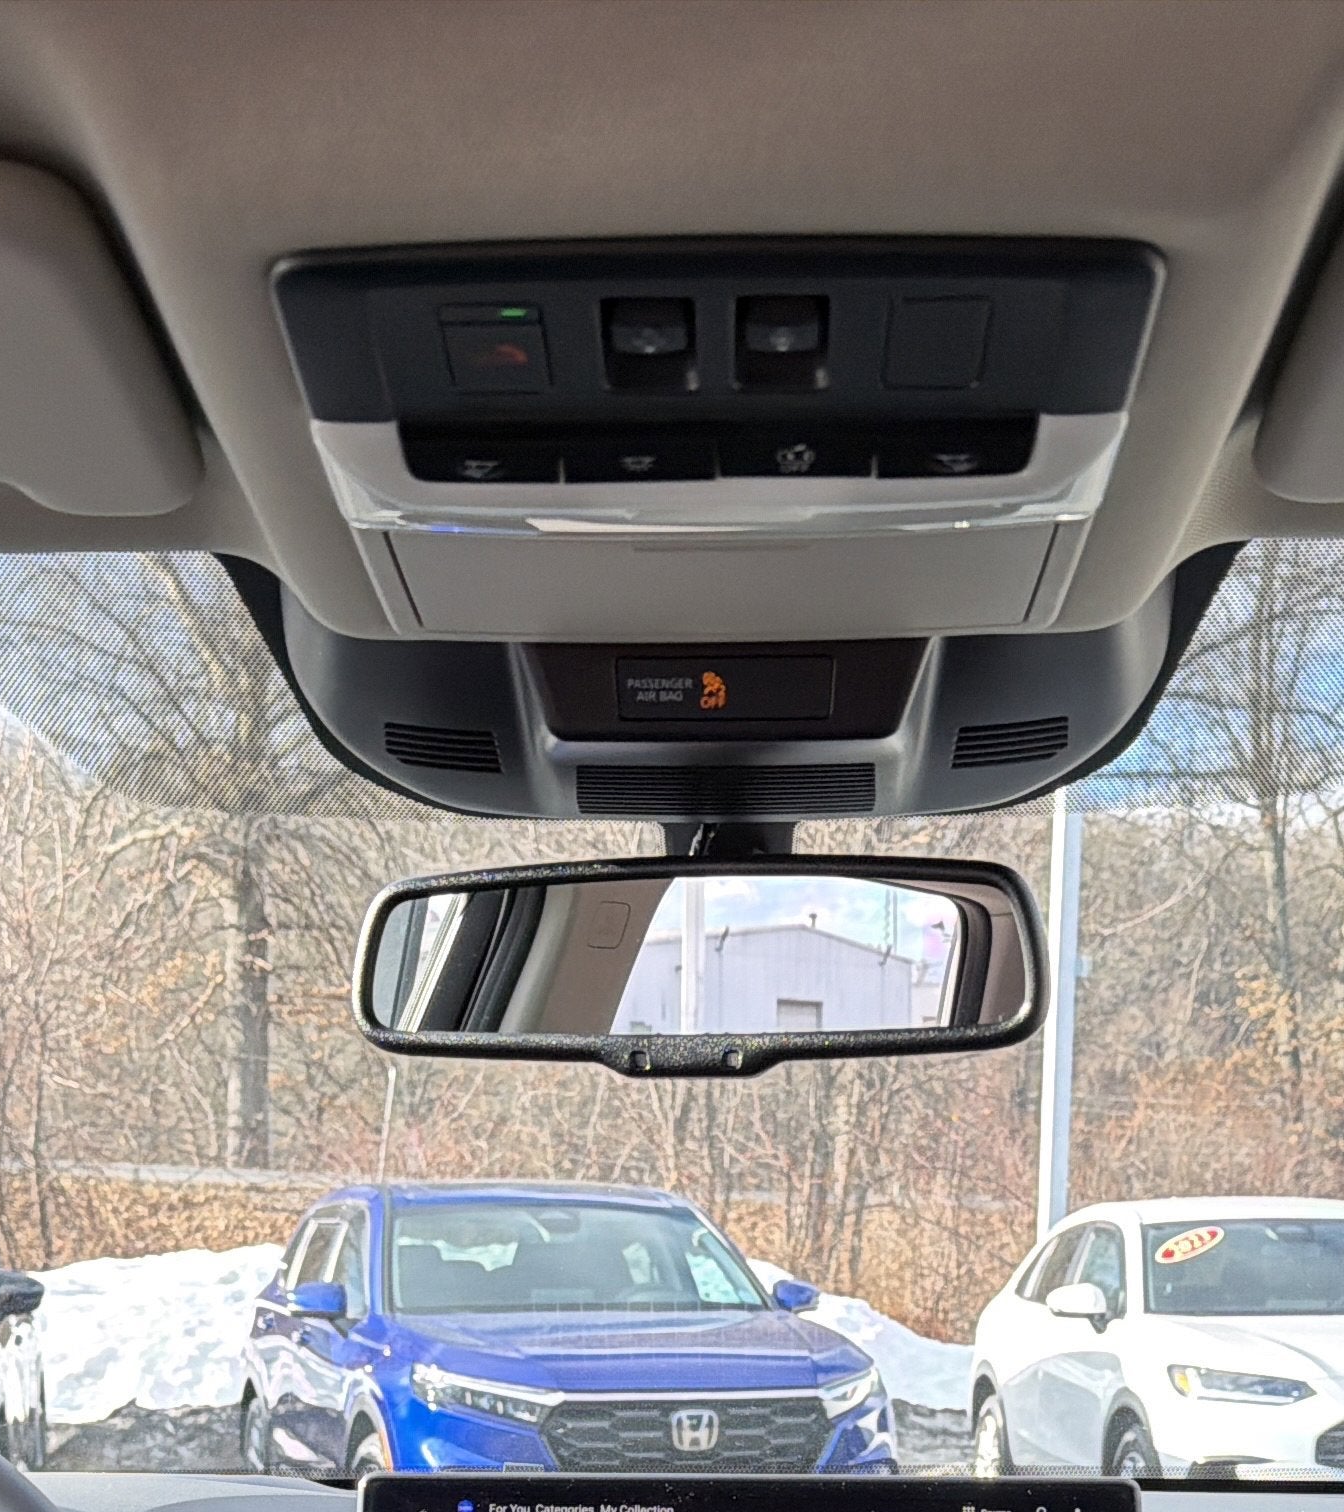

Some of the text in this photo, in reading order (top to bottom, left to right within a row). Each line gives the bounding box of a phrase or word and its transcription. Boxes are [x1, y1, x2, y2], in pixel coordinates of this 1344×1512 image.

[627, 678, 693, 689] PASSENGER
[637, 690, 683, 702] AIR BAG
